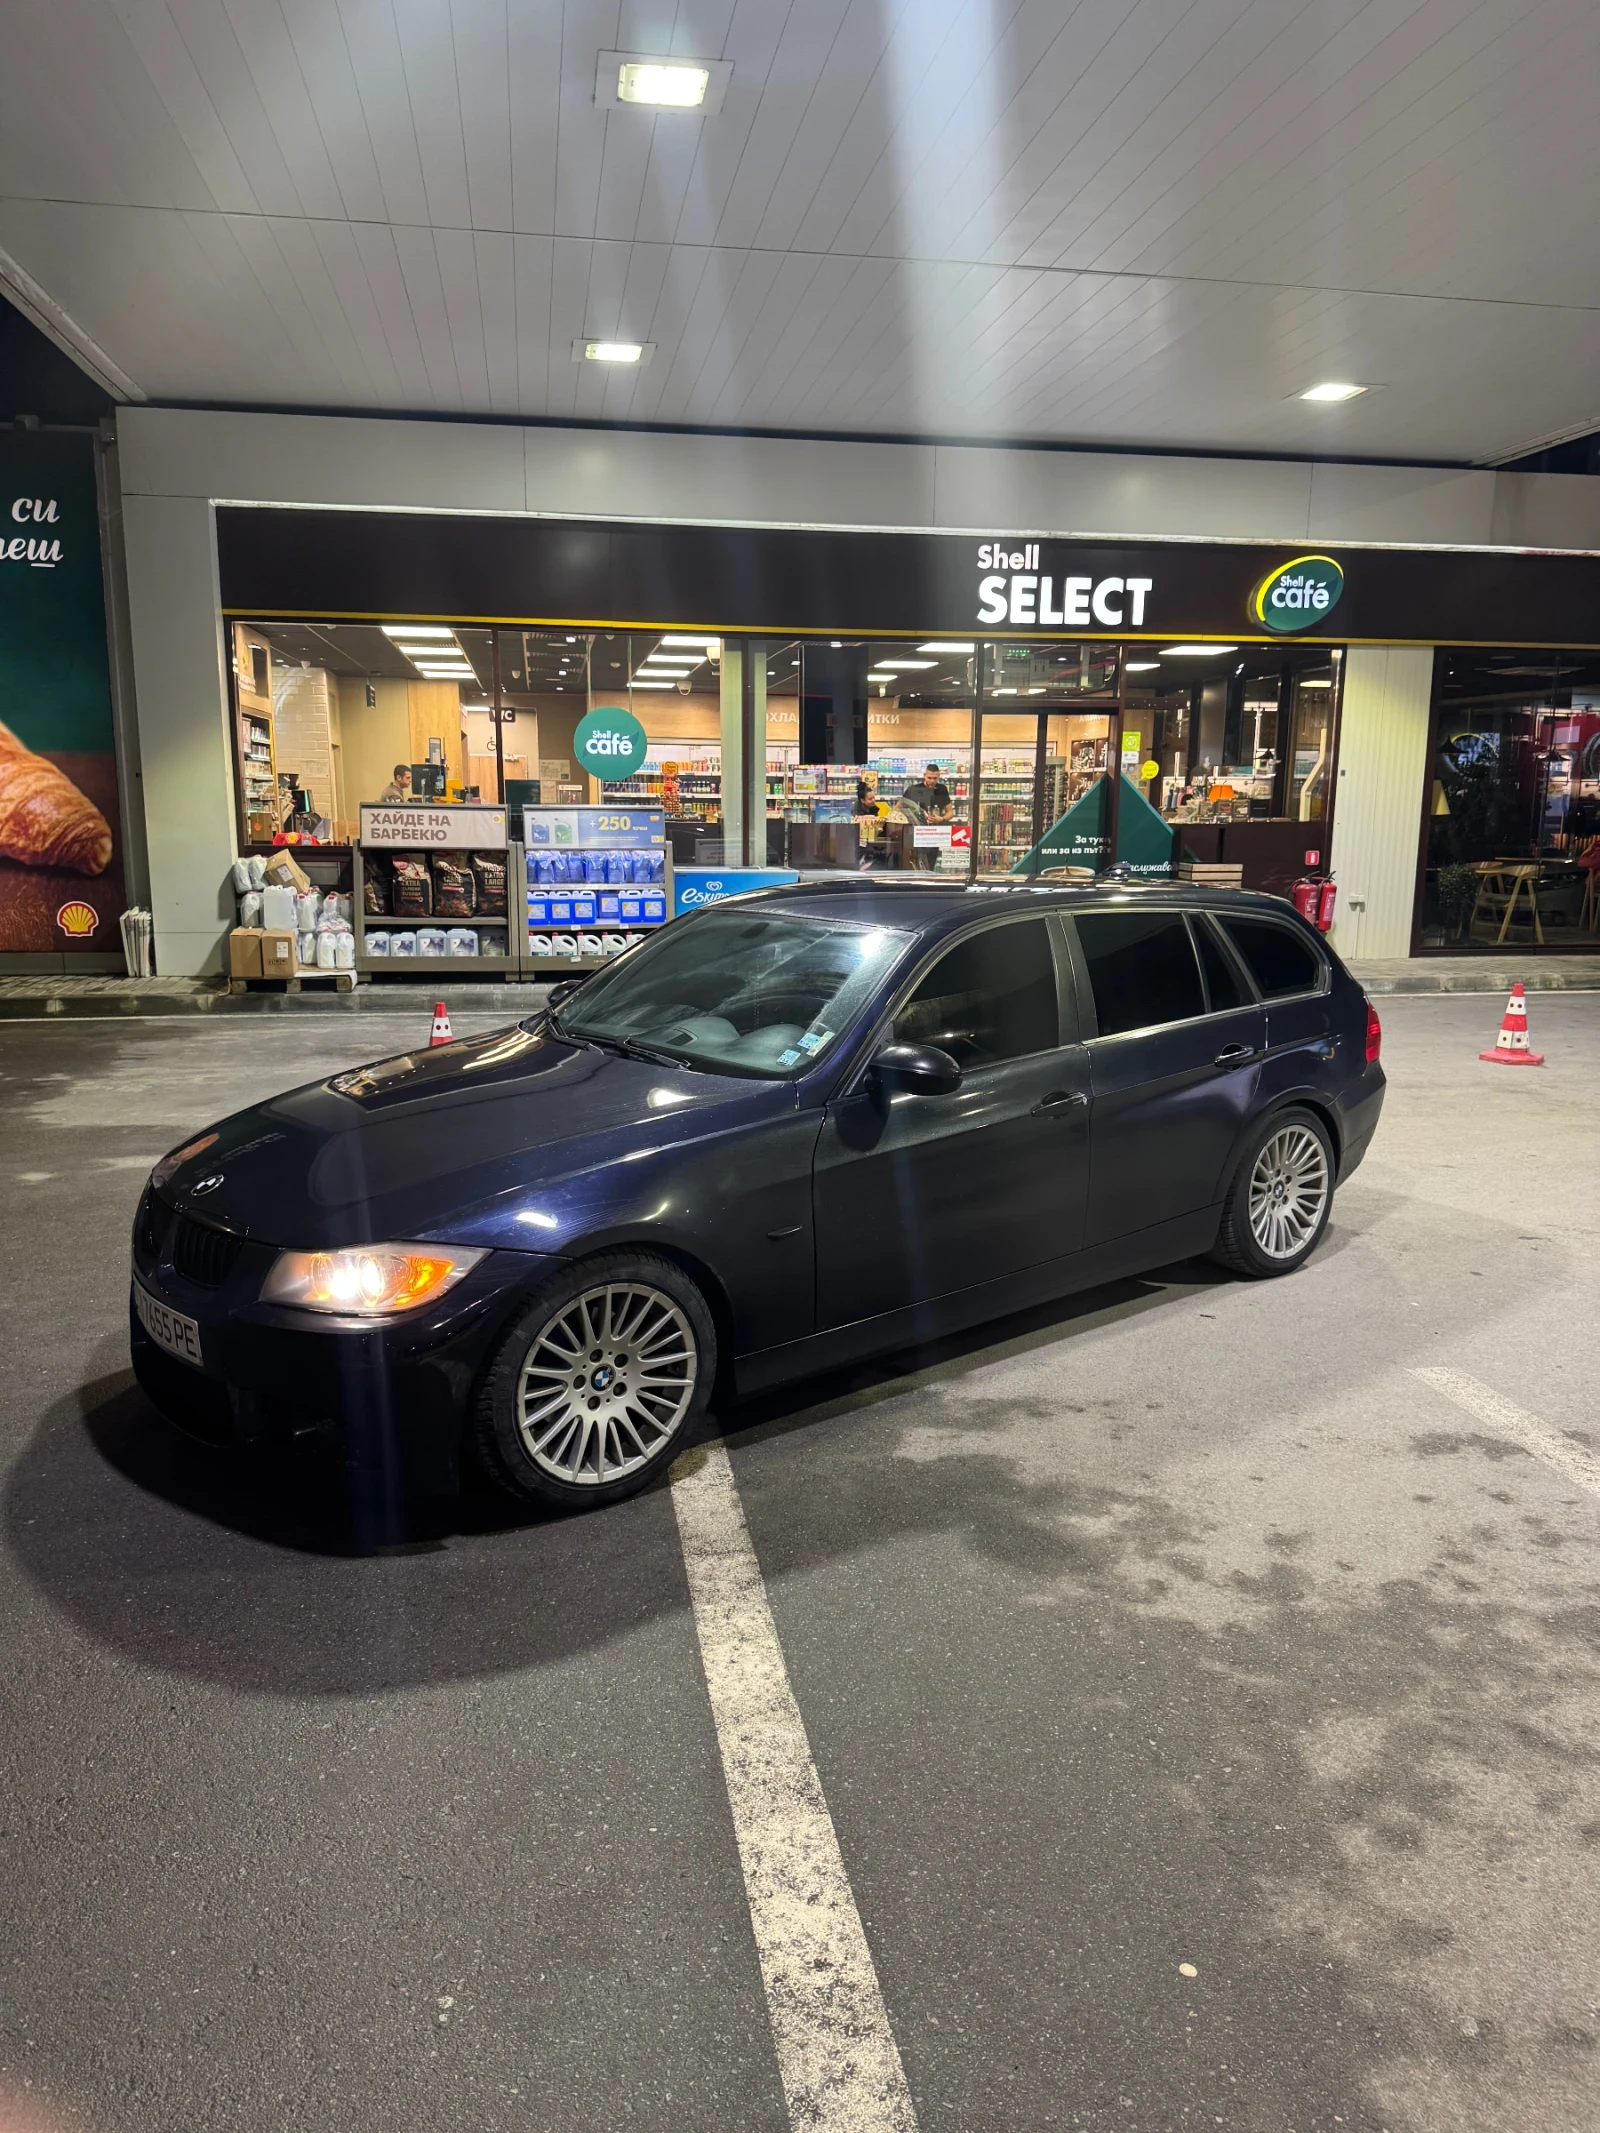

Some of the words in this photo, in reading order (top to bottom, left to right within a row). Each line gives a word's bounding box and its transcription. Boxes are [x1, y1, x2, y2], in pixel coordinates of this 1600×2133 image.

[11, 497, 60, 523] си
[976, 543, 1040, 570] Shell
[1280, 575, 1304, 587] Shell
[976, 575, 1153, 626] SELECT
[1271, 579, 1330, 610] café
[765, 712, 799, 723] ХЛА
[592, 730, 612, 739] Shell
[585, 732, 633, 756] café
[370, 811, 425, 827] ХАЙДЕ
[428, 814, 451, 827] НА
[370, 827, 448, 841] БАРБЕКЮ
[1075, 835, 1087, 844] За
[1059, 847, 1070, 855] за
